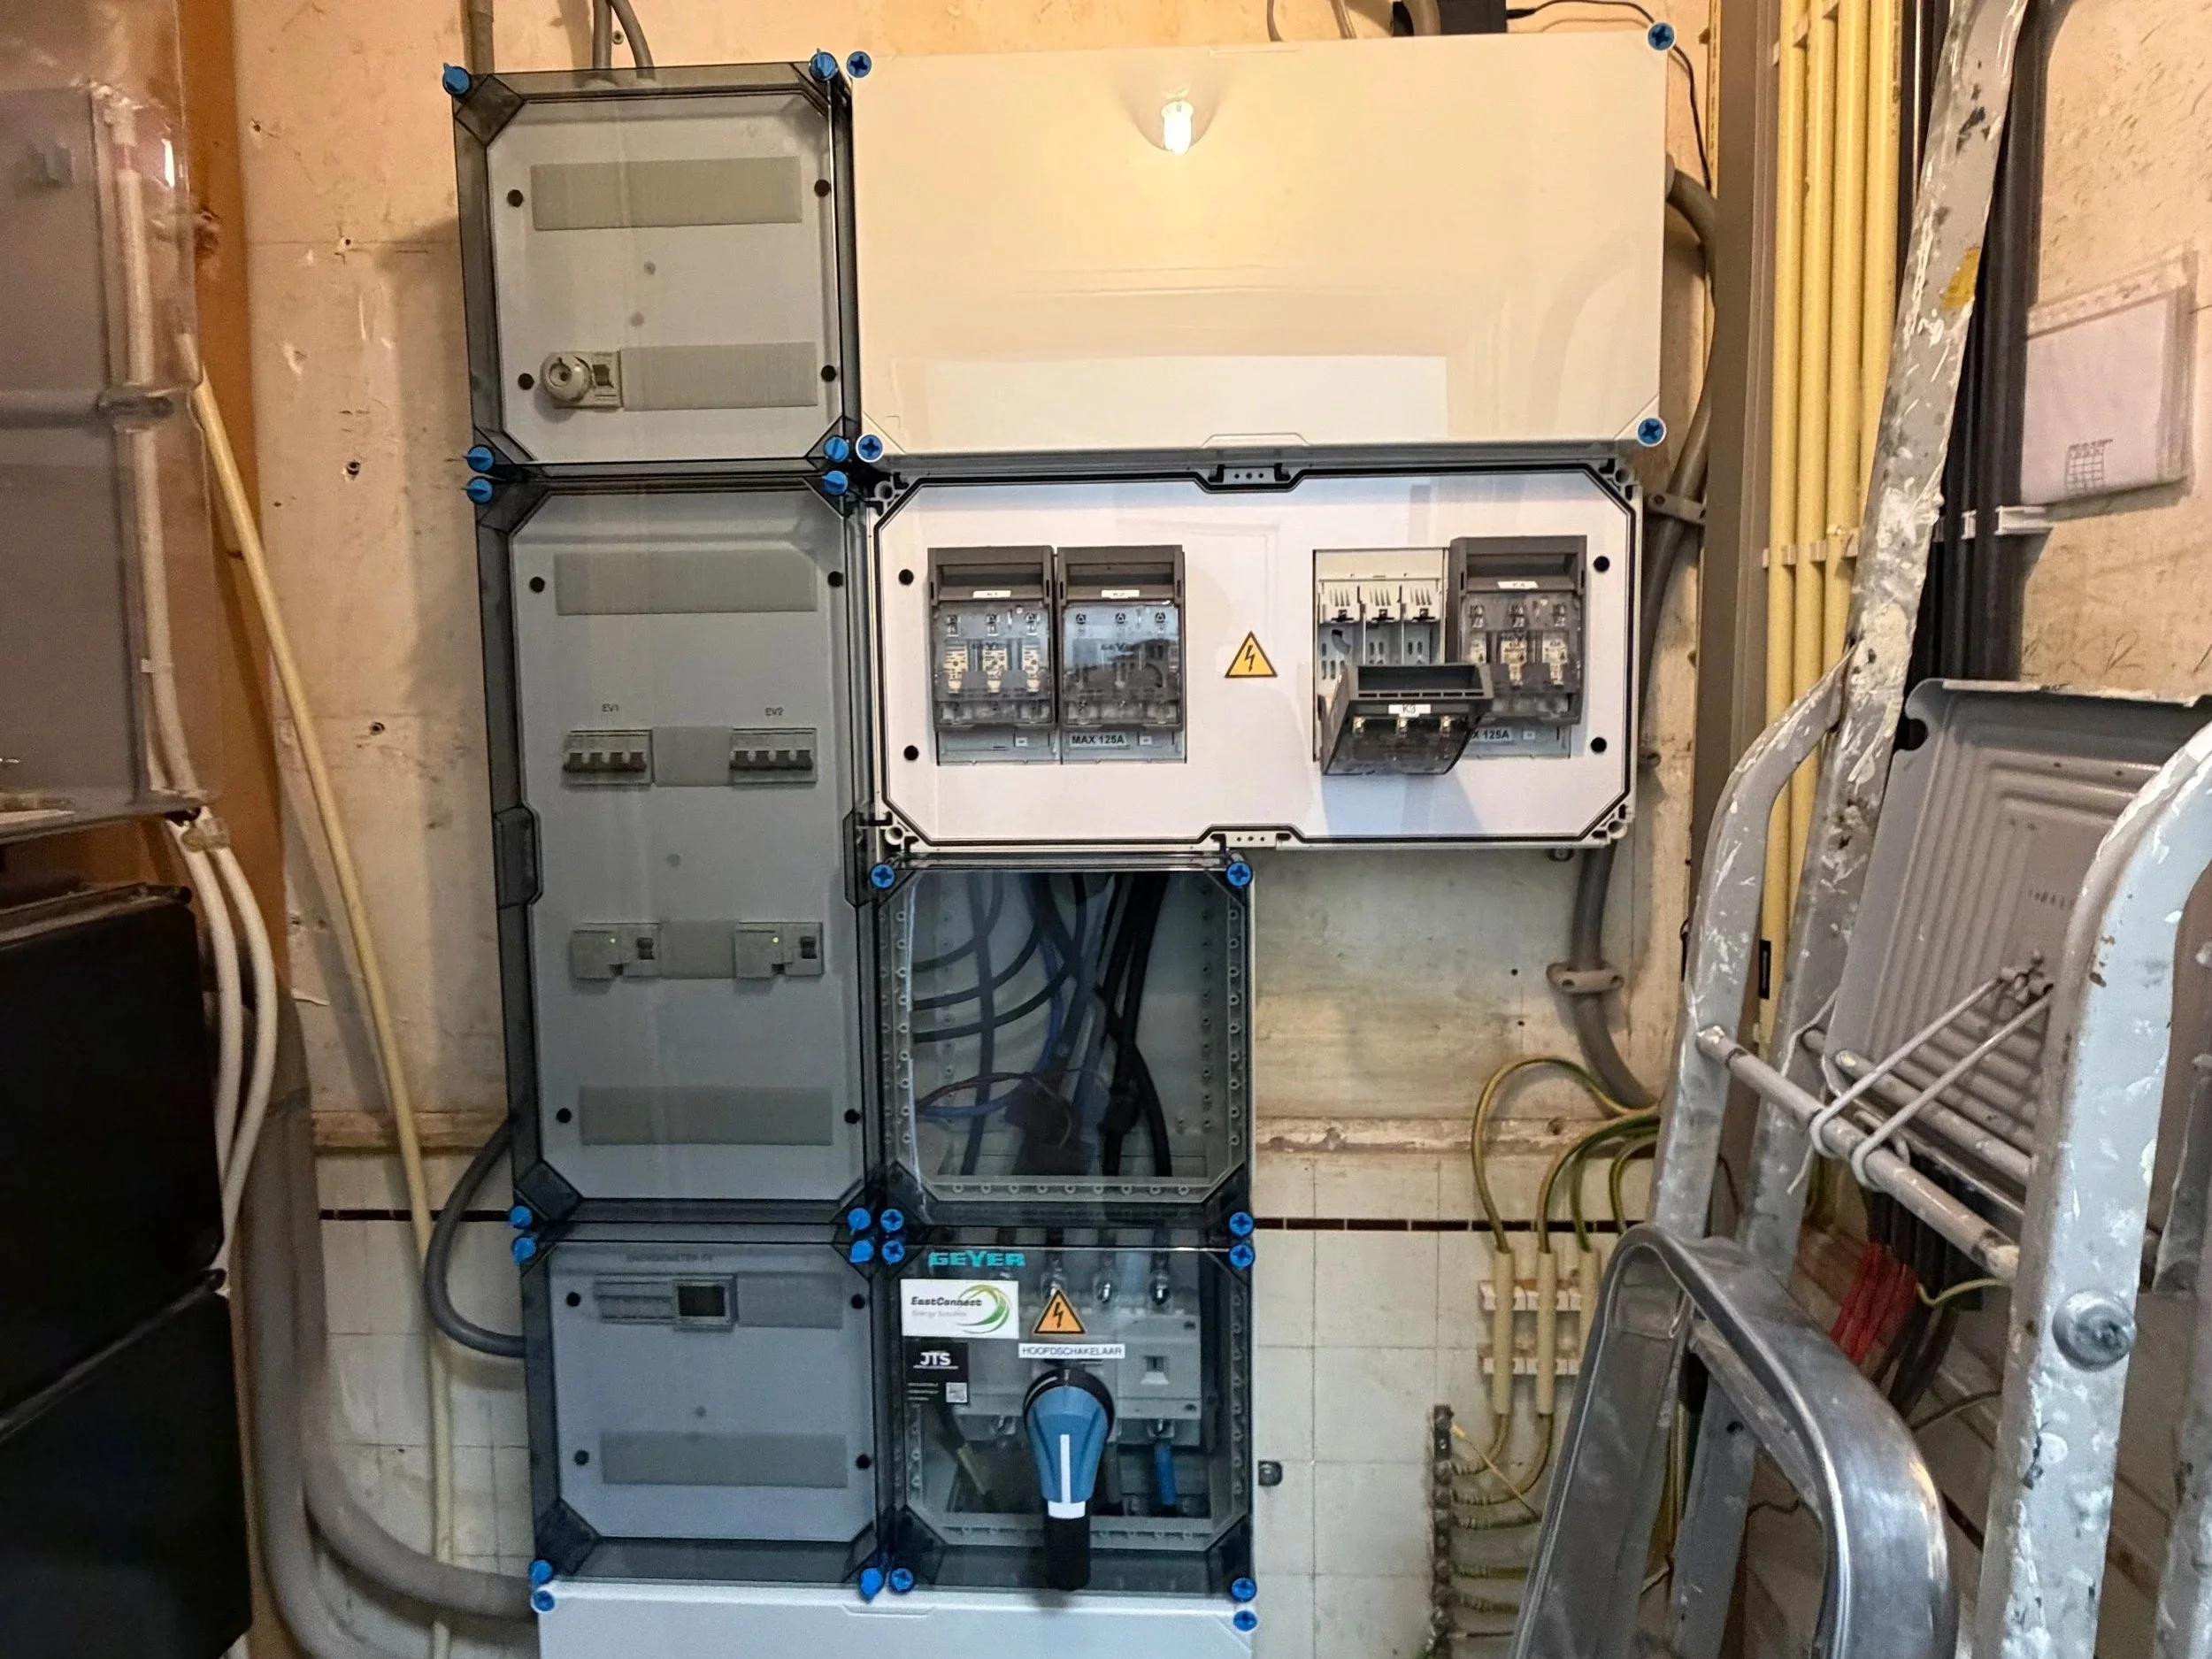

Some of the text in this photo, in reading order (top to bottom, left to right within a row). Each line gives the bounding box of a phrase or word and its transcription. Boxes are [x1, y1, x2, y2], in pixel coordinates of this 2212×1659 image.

[602, 703, 619, 712] EV1
[764, 706, 784, 716] EV2
[1071, 734, 1125, 744] MAX 125A
[1483, 730, 1509, 741] 125A
[928, 1250, 1026, 1268] GEYER
[910, 1296, 983, 1307] EastConnect
[1022, 1347, 1122, 1356] HOOFDSCHAKELAAR
[919, 1352, 951, 1366] JTS
